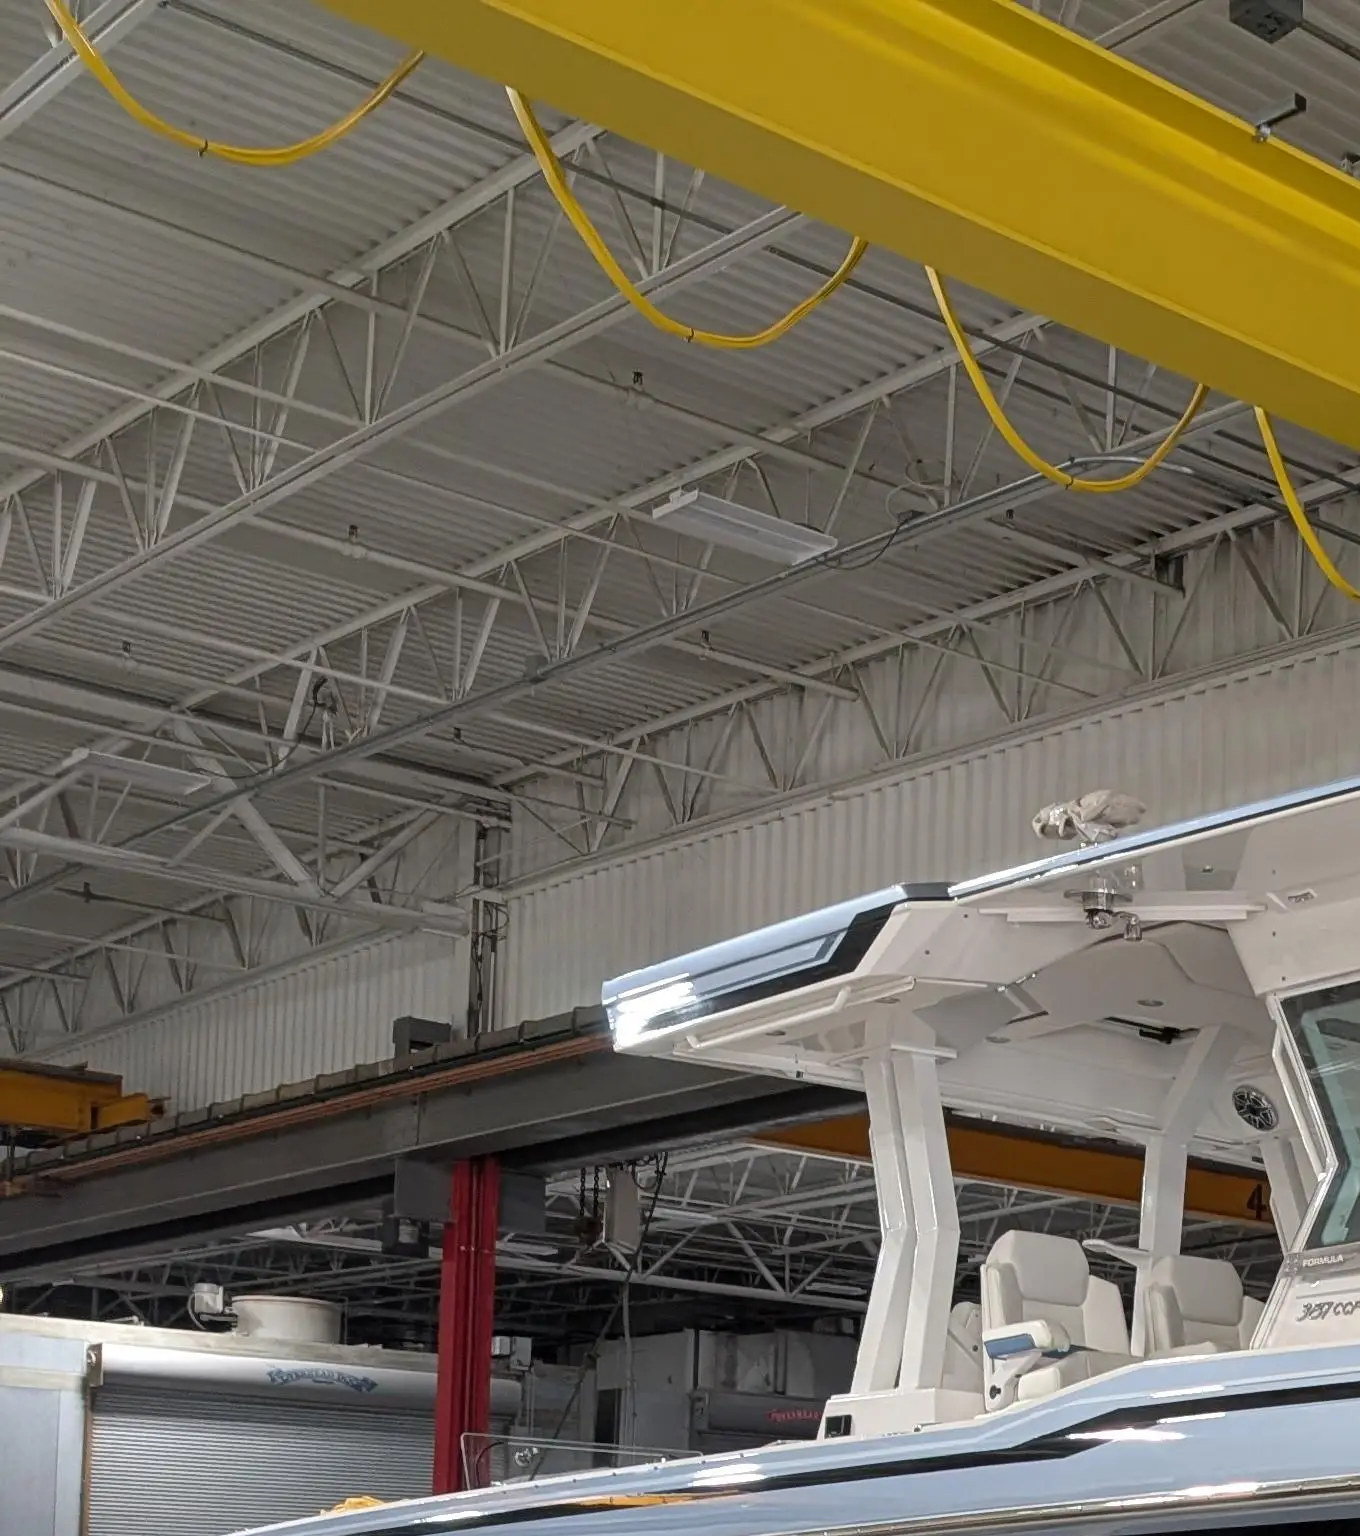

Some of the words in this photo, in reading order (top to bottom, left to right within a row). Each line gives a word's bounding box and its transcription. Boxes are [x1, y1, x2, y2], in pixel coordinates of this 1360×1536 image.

[1247, 1183, 1268, 1220] 4
[1302, 1254, 1344, 1268] FORMULA
[1296, 1301, 1334, 1322] 387
